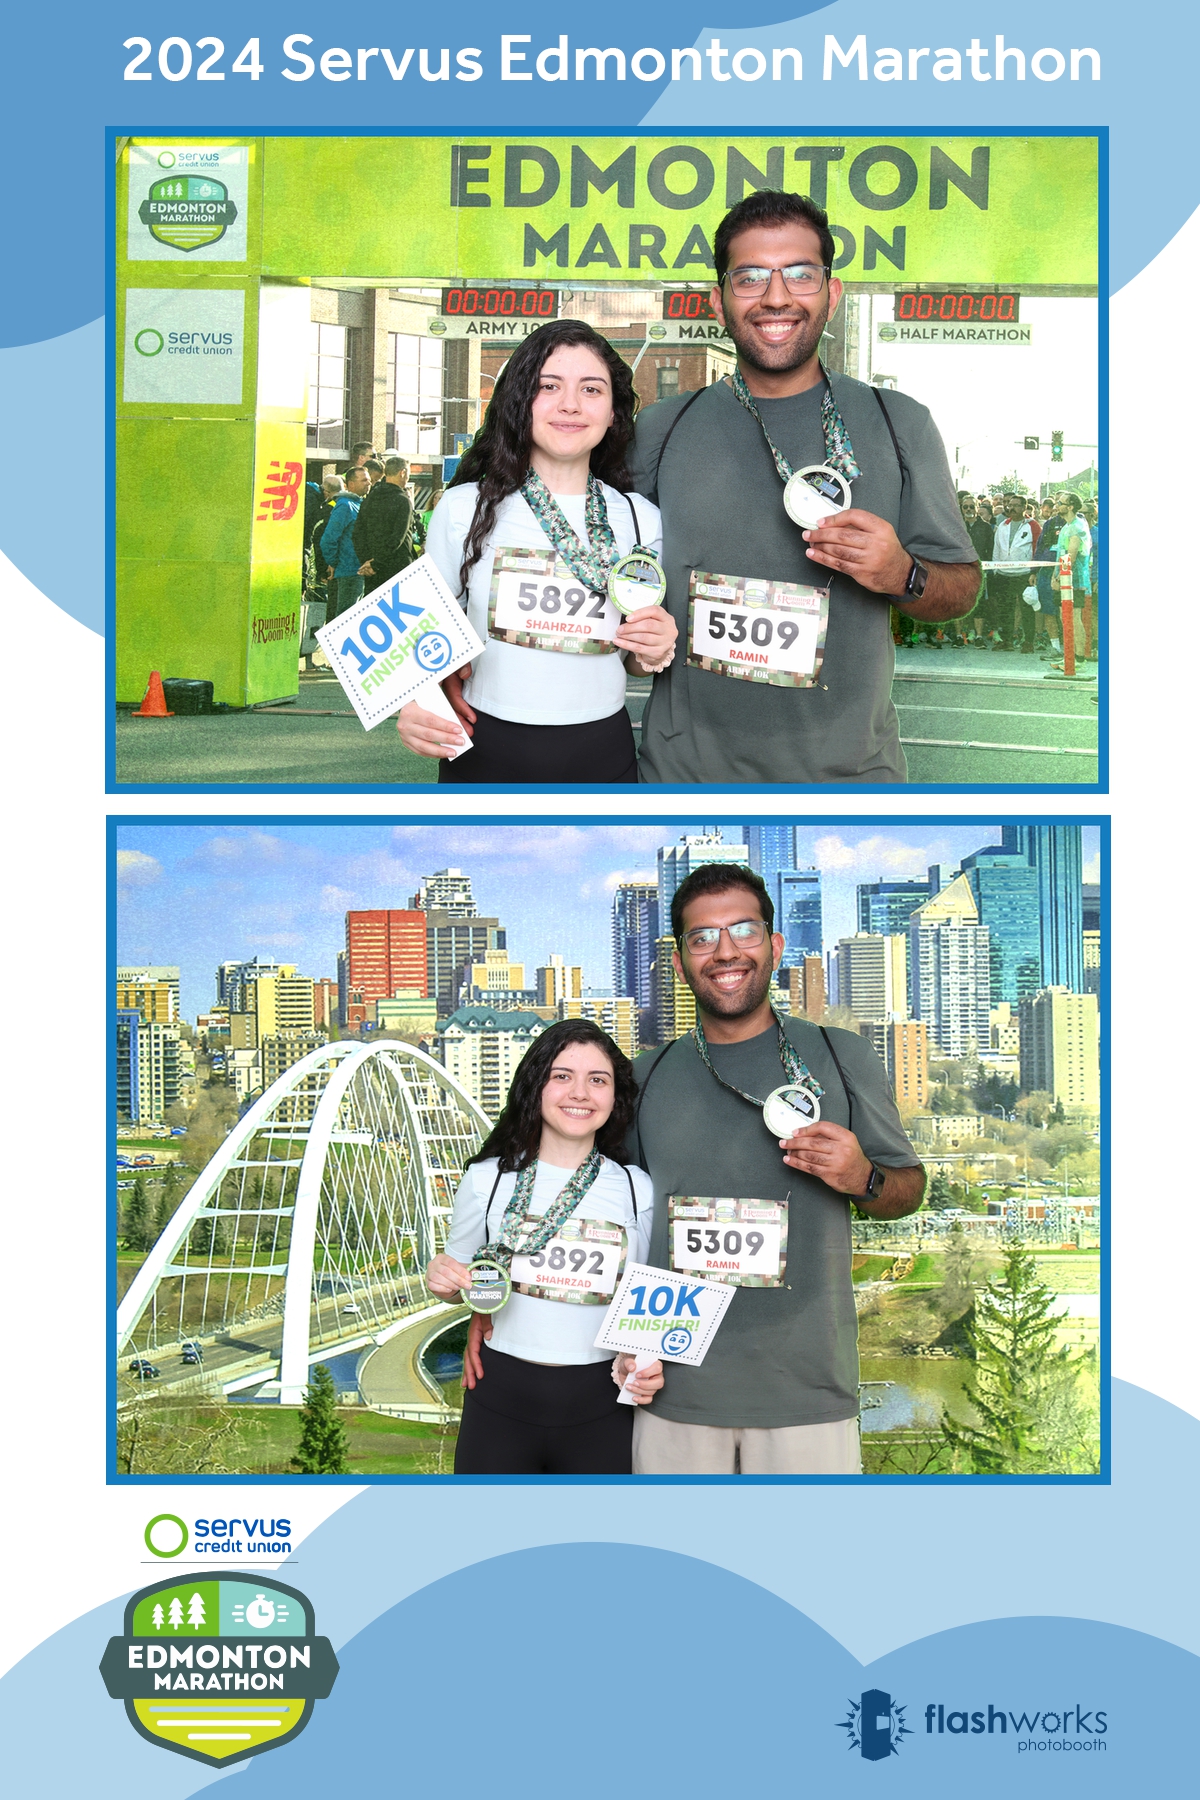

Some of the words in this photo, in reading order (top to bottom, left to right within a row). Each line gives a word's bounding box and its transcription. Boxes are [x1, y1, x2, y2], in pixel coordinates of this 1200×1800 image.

[178, 152, 219, 161] servus
[449, 145, 991, 212] EDMONTON
[150, 203, 226, 213] EDMONTON
[160, 214, 215, 222] MARATHON
[466, 322, 518, 335] ARMY
[522, 323, 543, 336] 10
[900, 328, 938, 340] HALF
[942, 328, 1030, 340] MARATHON
[168, 332, 232, 344] servus
[168, 345, 200, 354] credit
[203, 347, 232, 355] union
[518, 558, 542, 566] servus
[708, 585, 732, 594] servus
[518, 582, 606, 619] 5892
[258, 614, 290, 641] Running
[340, 581, 426, 675] 10K
[526, 618, 592, 634] SHAHRZAD
[708, 610, 799, 650] 5309
[535, 636, 561, 648] ARMY
[564, 639, 580, 648] 10K
[360, 612, 440, 696] FINISHER!
[729, 649, 769, 664] RAMIN
[726, 665, 750, 676] ARMY
[753, 670, 769, 679] 10K
[687, 1228, 764, 1256] 5309
[706, 1260, 740, 1269] RAMIN
[536, 1274, 592, 1288] SHAHRZAD
[705, 1274, 726, 1282] ARMY
[544, 1289, 565, 1298] ARMY
[568, 1291, 581, 1299] 10K
[627, 1286, 706, 1316] 10K
[618, 1318, 700, 1332] FINISHER!
